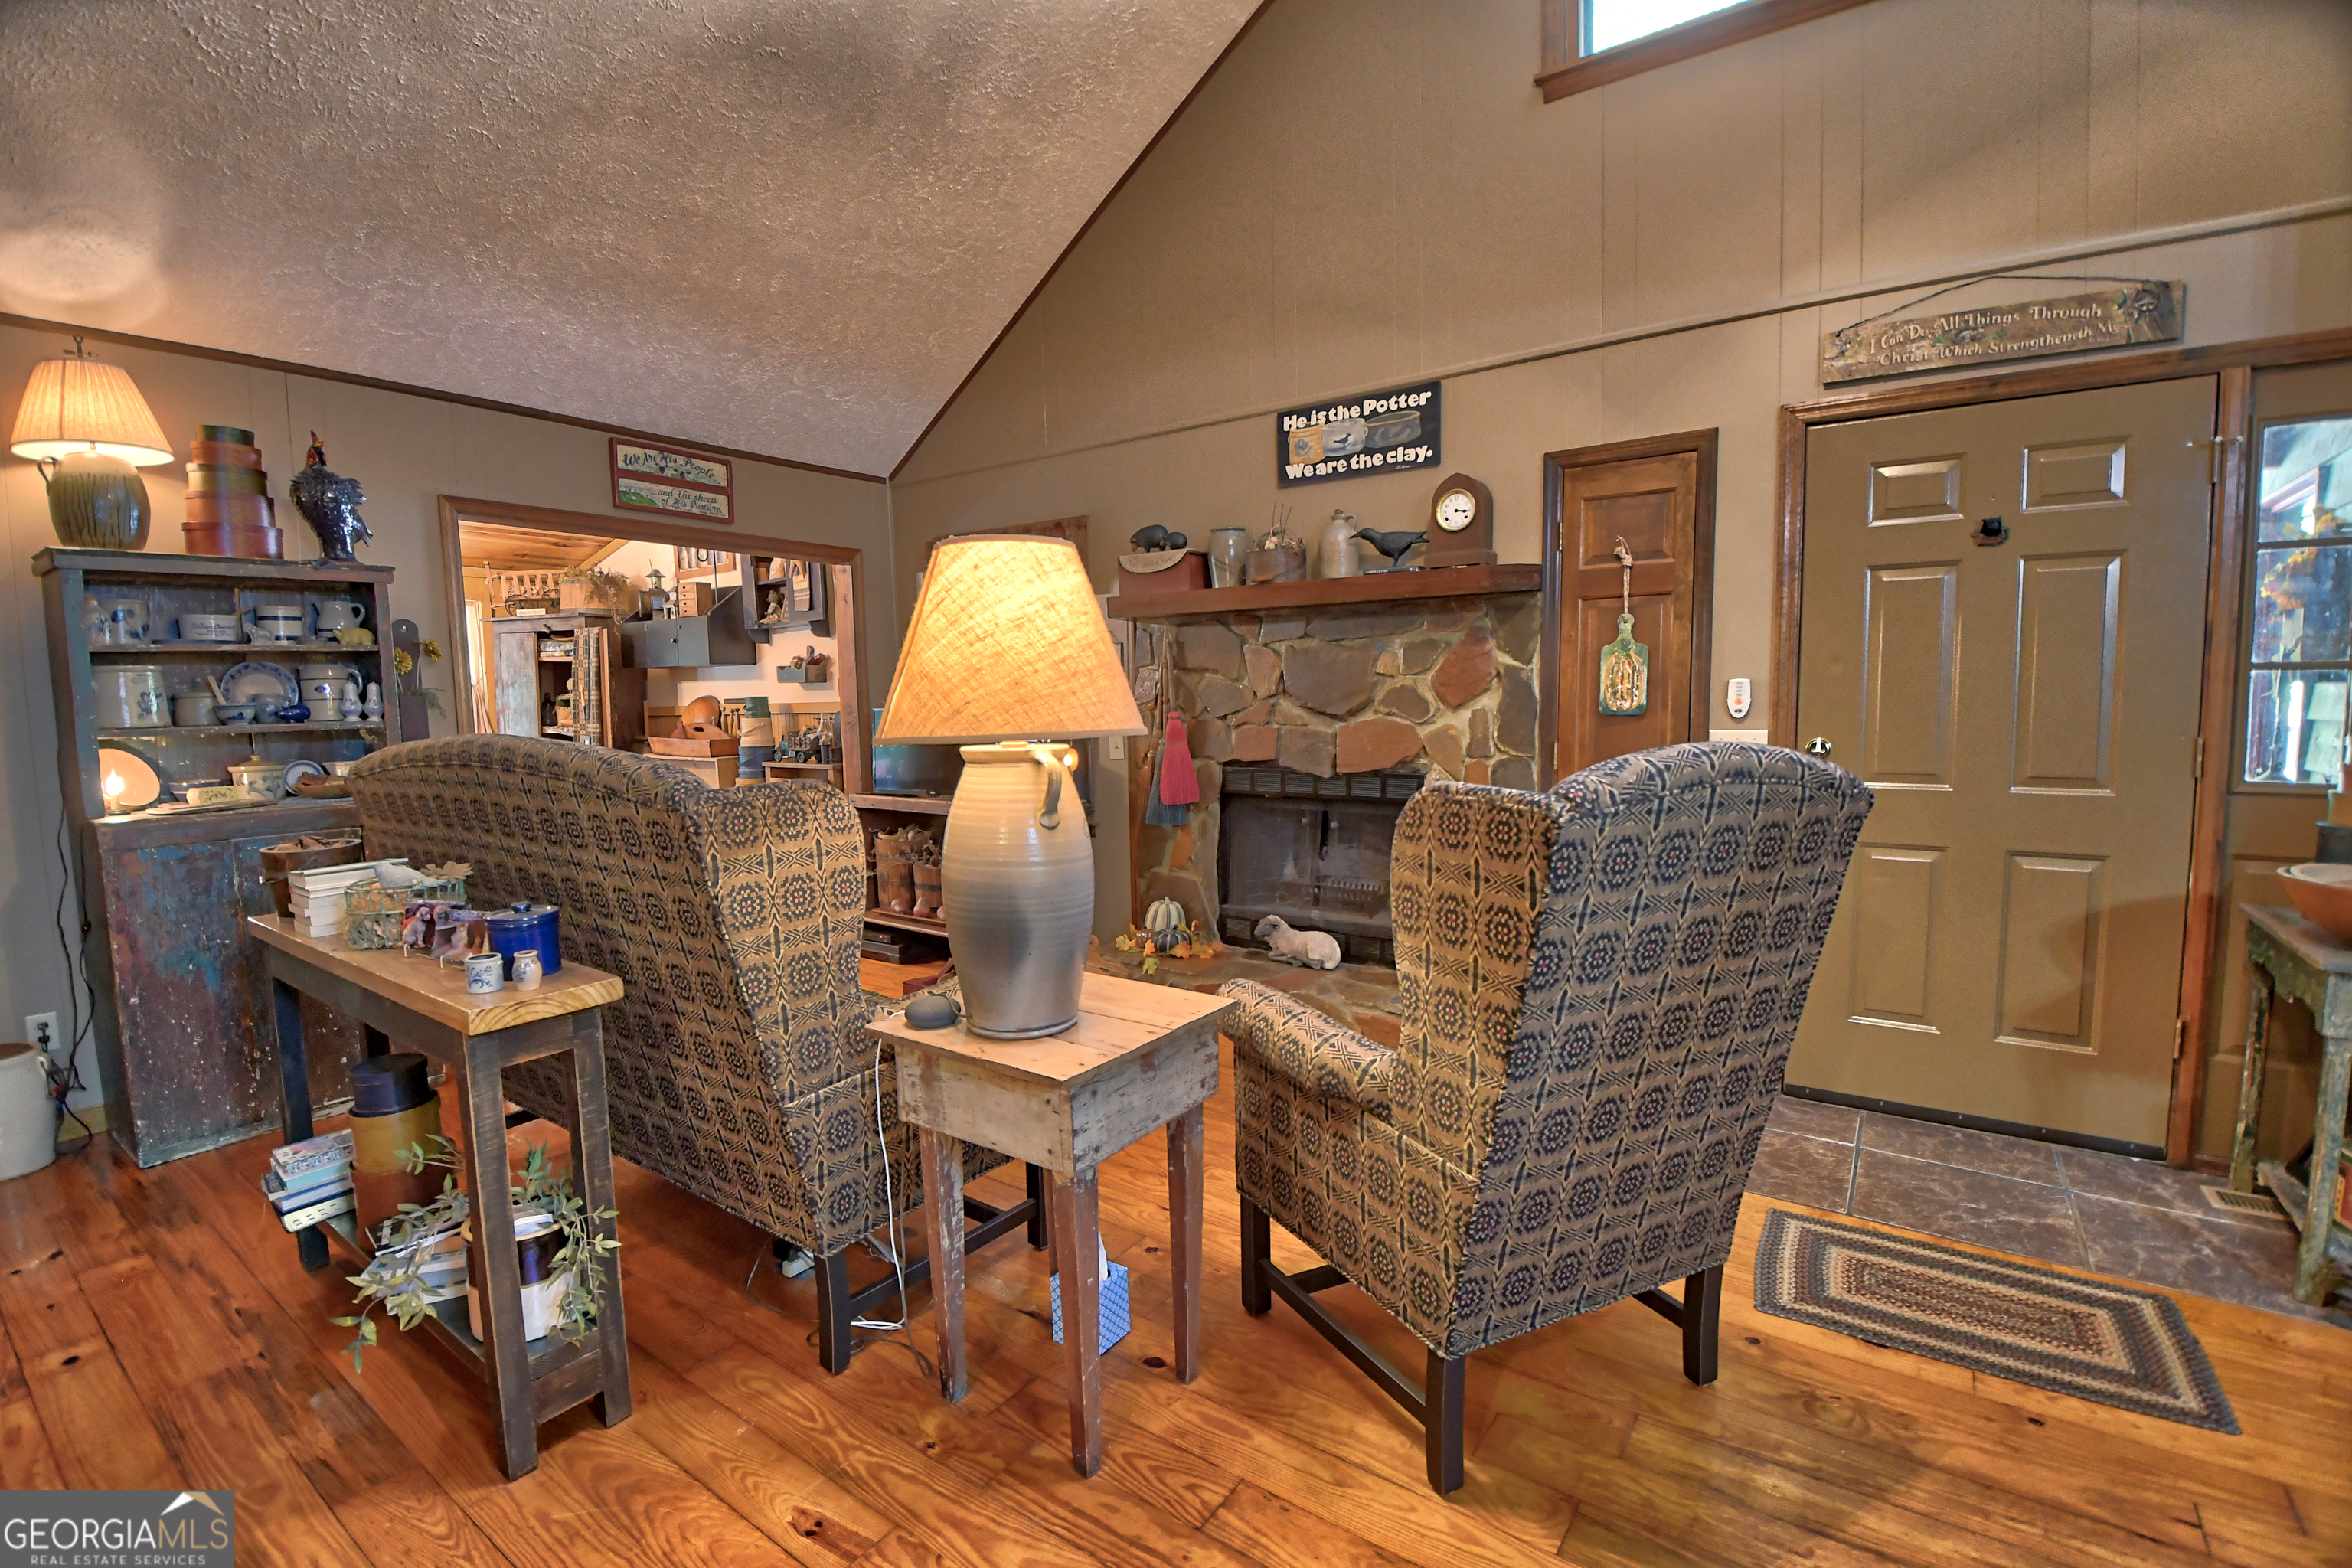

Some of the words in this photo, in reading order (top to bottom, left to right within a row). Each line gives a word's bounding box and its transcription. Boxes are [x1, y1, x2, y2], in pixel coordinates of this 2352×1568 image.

[1880, 332, 1904, 349] Can
[1939, 315, 1959, 331] All
[1965, 312, 2020, 327] Things
[2029, 303, 2102, 322] Through
[1880, 351, 1929, 366] Christ
[1939, 343, 1983, 358] Which
[1283, 414, 1308, 432] He
[1310, 410, 1327, 426] is
[1328, 405, 1361, 423] the
[1363, 390, 1432, 416] Potter
[623, 452, 641, 466] We
[641, 452, 657, 466] Are
[1285, 463, 1315, 479] We
[1315, 461, 1348, 475] are
[1350, 453, 1385, 469] the
[1386, 444, 1434, 465] clay.
[660, 498, 670, 507] of
[673, 498, 688, 508] His
[691, 501, 723, 514] Pasture.
[678, 490, 691, 500] the
[694, 493, 717, 505] sheep
